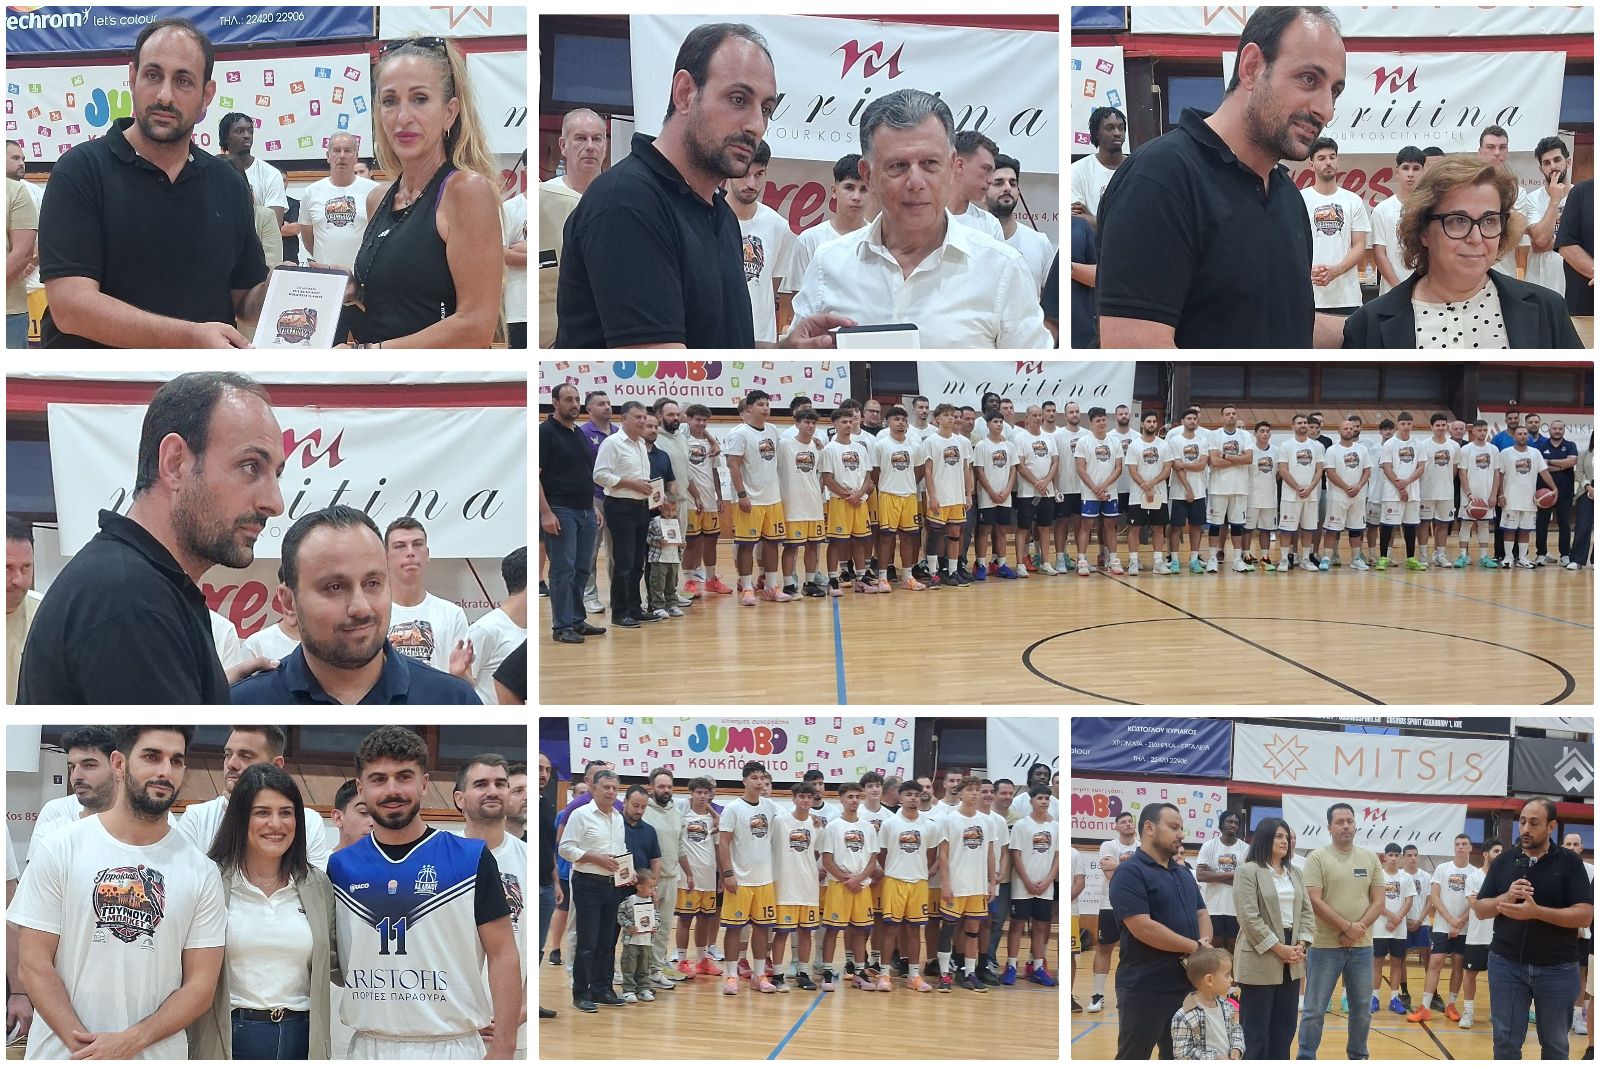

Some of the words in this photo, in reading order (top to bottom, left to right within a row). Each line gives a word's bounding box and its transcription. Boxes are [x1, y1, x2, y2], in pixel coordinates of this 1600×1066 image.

[6, 13, 81, 30] echrom
[93, 15, 117, 27] let's
[119, 14, 158, 26] colour
[246, 14, 274, 25] 22420
[275, 11, 305, 23] 22906
[1325, 98, 1523, 128] ritina
[818, 131, 853, 143] KOS
[1360, 131, 1385, 140] KOS
[1390, 131, 1418, 140] CITY
[1424, 131, 1464, 140] HOTEL
[614, 381, 724, 397] κουκλόσπιτο
[773, 523, 785, 534] 15
[1407, 718, 1422, 726] SPORT
[1127, 725, 1165, 734] ΚΩΣΤΟΓΛΟΥ
[688, 723, 788, 756] JUMBO
[688, 755, 788, 771] κουκλόπιτο
[1334, 744, 1485, 784] MITSIS
[1071, 793, 1123, 818] MBO
[1071, 817, 1117, 831] λόσπιτ
[101, 906, 153, 926] ΤΟΥΡΝΟΥΑ
[763, 906, 775, 918] 15
[808, 910, 815, 922] 8
[376, 917, 407, 955] 11
[352, 991, 386, 1001] ΠΟΡΤΕΣ
[391, 992, 447, 1002] ΠΑΡΑΘΥΡΑ
